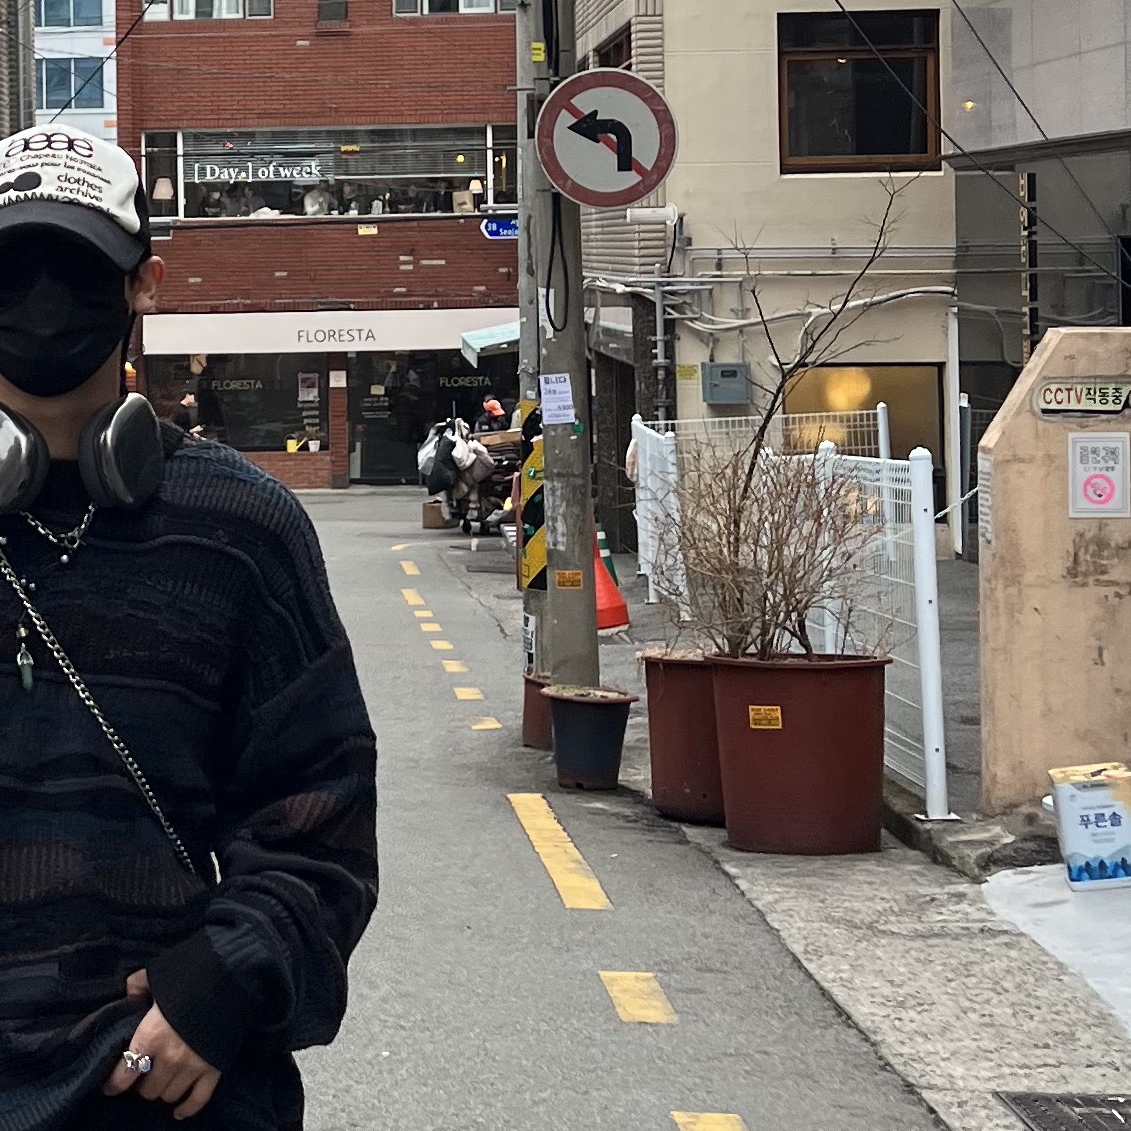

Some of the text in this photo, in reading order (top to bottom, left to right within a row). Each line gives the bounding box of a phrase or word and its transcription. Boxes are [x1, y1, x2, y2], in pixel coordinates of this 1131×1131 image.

[258, 162, 277, 179] of
[278, 161, 322, 178] week
[56, 173, 103, 194] clothes
[55, 185, 103, 203] archive
[297, 328, 376, 343] FLORESTA
[211, 379, 263, 391] FLORESTA
[439, 376, 491, 388] FLORESTA
[1078, 812, 1123, 830] 푸른솔
